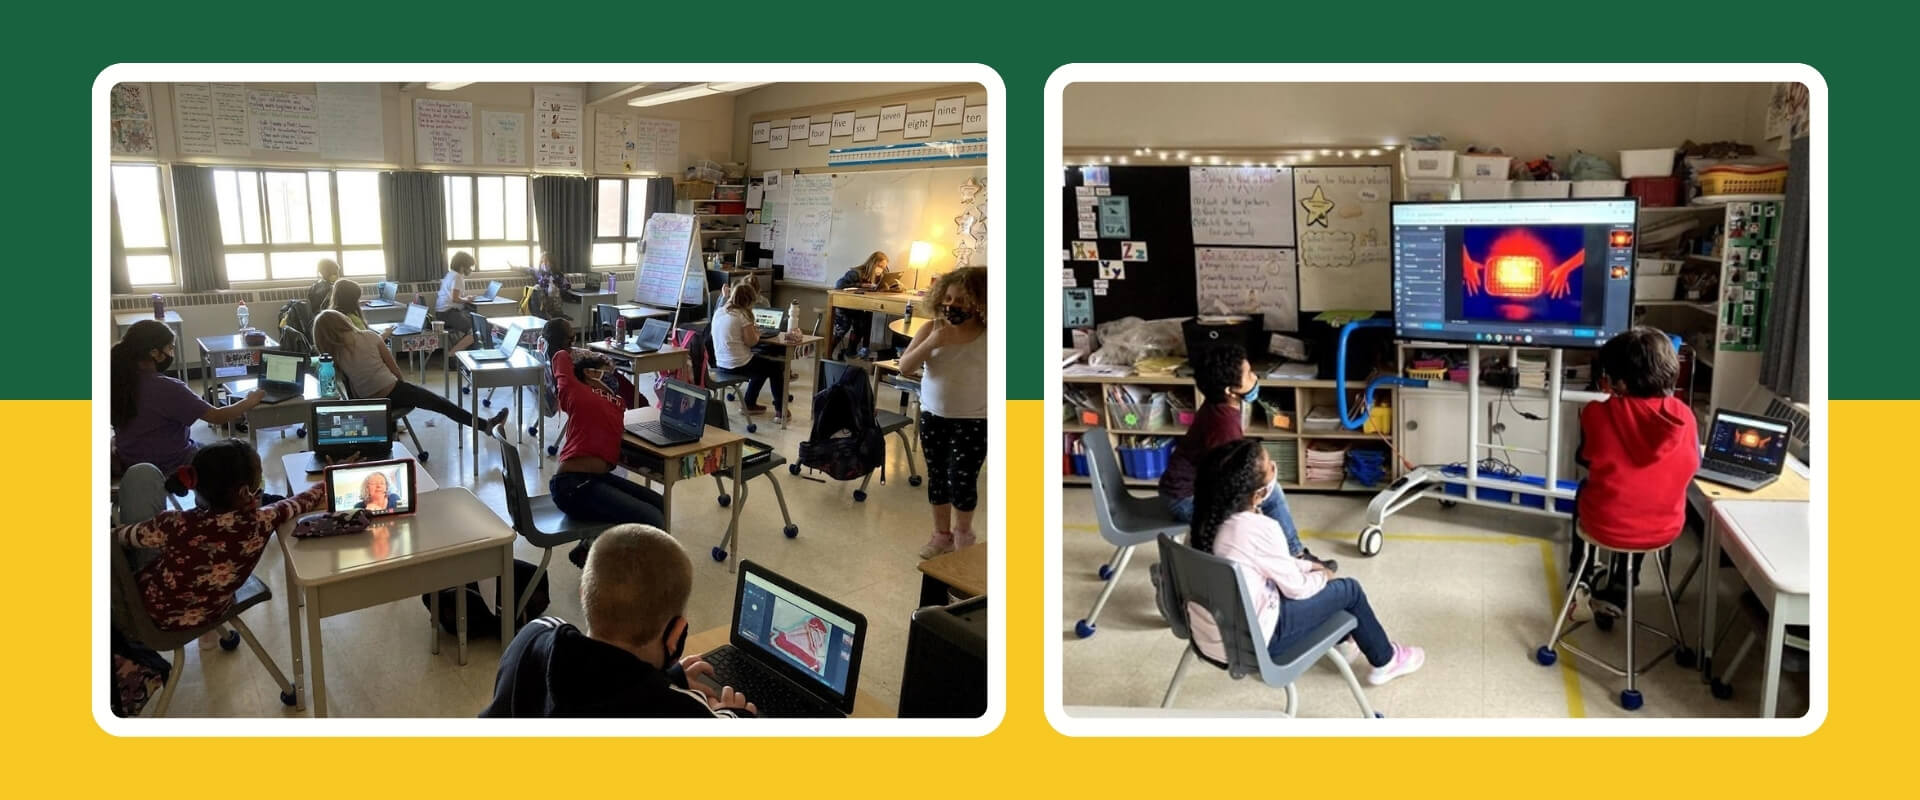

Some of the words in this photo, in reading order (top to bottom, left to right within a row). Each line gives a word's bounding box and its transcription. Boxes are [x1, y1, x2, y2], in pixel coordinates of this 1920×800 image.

[937, 105, 957, 115] nine
[882, 112, 901, 121] seven
[965, 114, 982, 123] ten
[834, 119, 847, 128] five
[907, 119, 929, 130] eight
[856, 125, 866, 133] six
[811, 130, 825, 138] four
